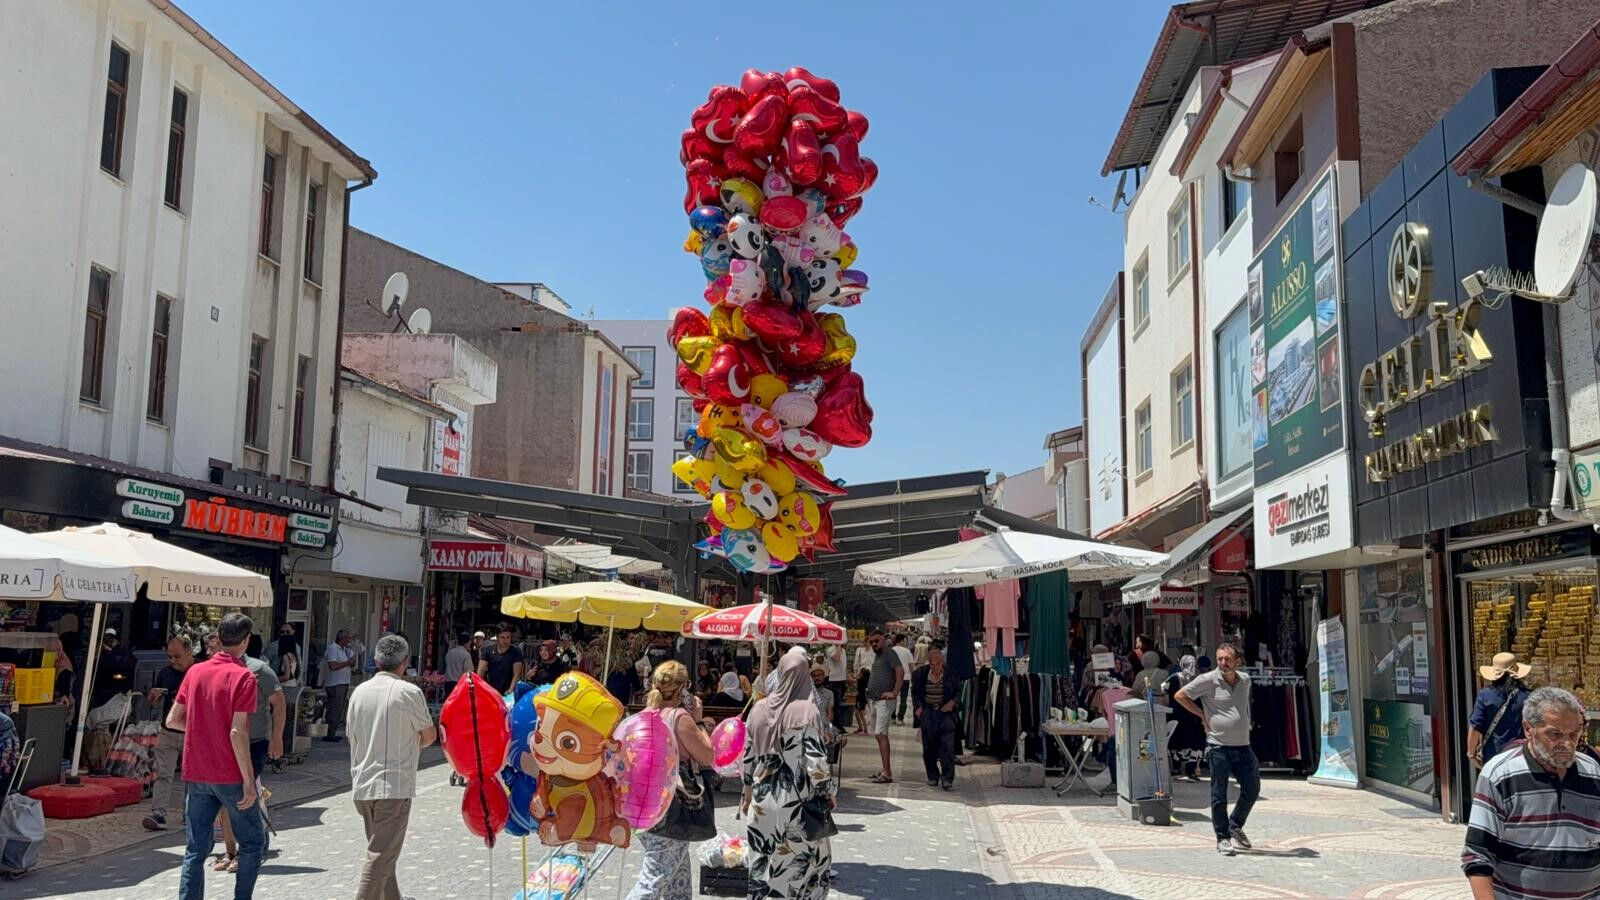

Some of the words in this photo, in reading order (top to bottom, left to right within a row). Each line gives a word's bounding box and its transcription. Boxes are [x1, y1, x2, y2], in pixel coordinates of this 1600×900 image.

[1271, 261, 1306, 318] ALUSSO
[1359, 297, 1492, 438] ÇELİK
[127, 481, 181, 503] Kuruyemiş
[132, 503, 171, 520] Baharat
[296, 515, 329, 530] Şekerleme
[297, 532, 325, 545] Bakliyat
[430, 548, 465, 566] KAAN
[467, 546, 504, 568] OPTİK
[1472, 543, 1513, 567] KADİR
[1013, 565, 1041, 576] HASAN
[1042, 560, 1064, 571] KOCA
[77, 579, 123, 594] GELATERIA
[920, 578, 943, 586] HASAN
[944, 577, 964, 586] KOCA
[168, 583, 180, 593] LA
[184, 584, 248, 600] GELATERIA
[1162, 595, 1195, 606] arçelik
[706, 623, 734, 633] ALGIDA
